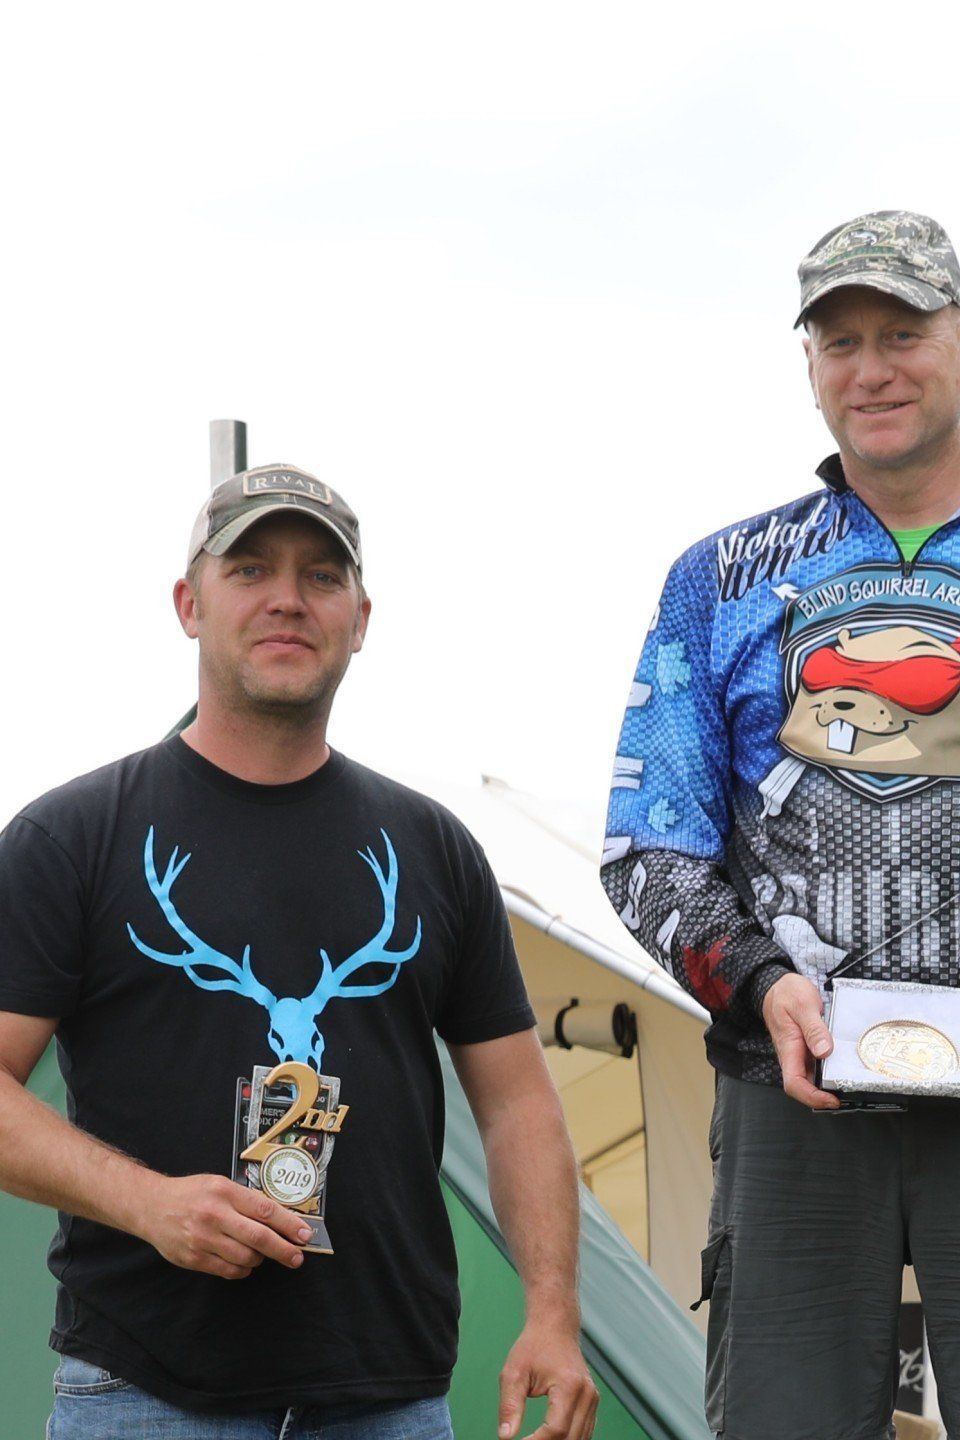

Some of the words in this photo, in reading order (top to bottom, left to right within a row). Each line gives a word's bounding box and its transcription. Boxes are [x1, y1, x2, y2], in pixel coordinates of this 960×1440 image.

[254, 475, 322, 497] RIVAL
[798, 583, 847, 619] BLIND
[850, 578, 930, 602] SQUIRREL
[274, 1168, 312, 1189] 2019
